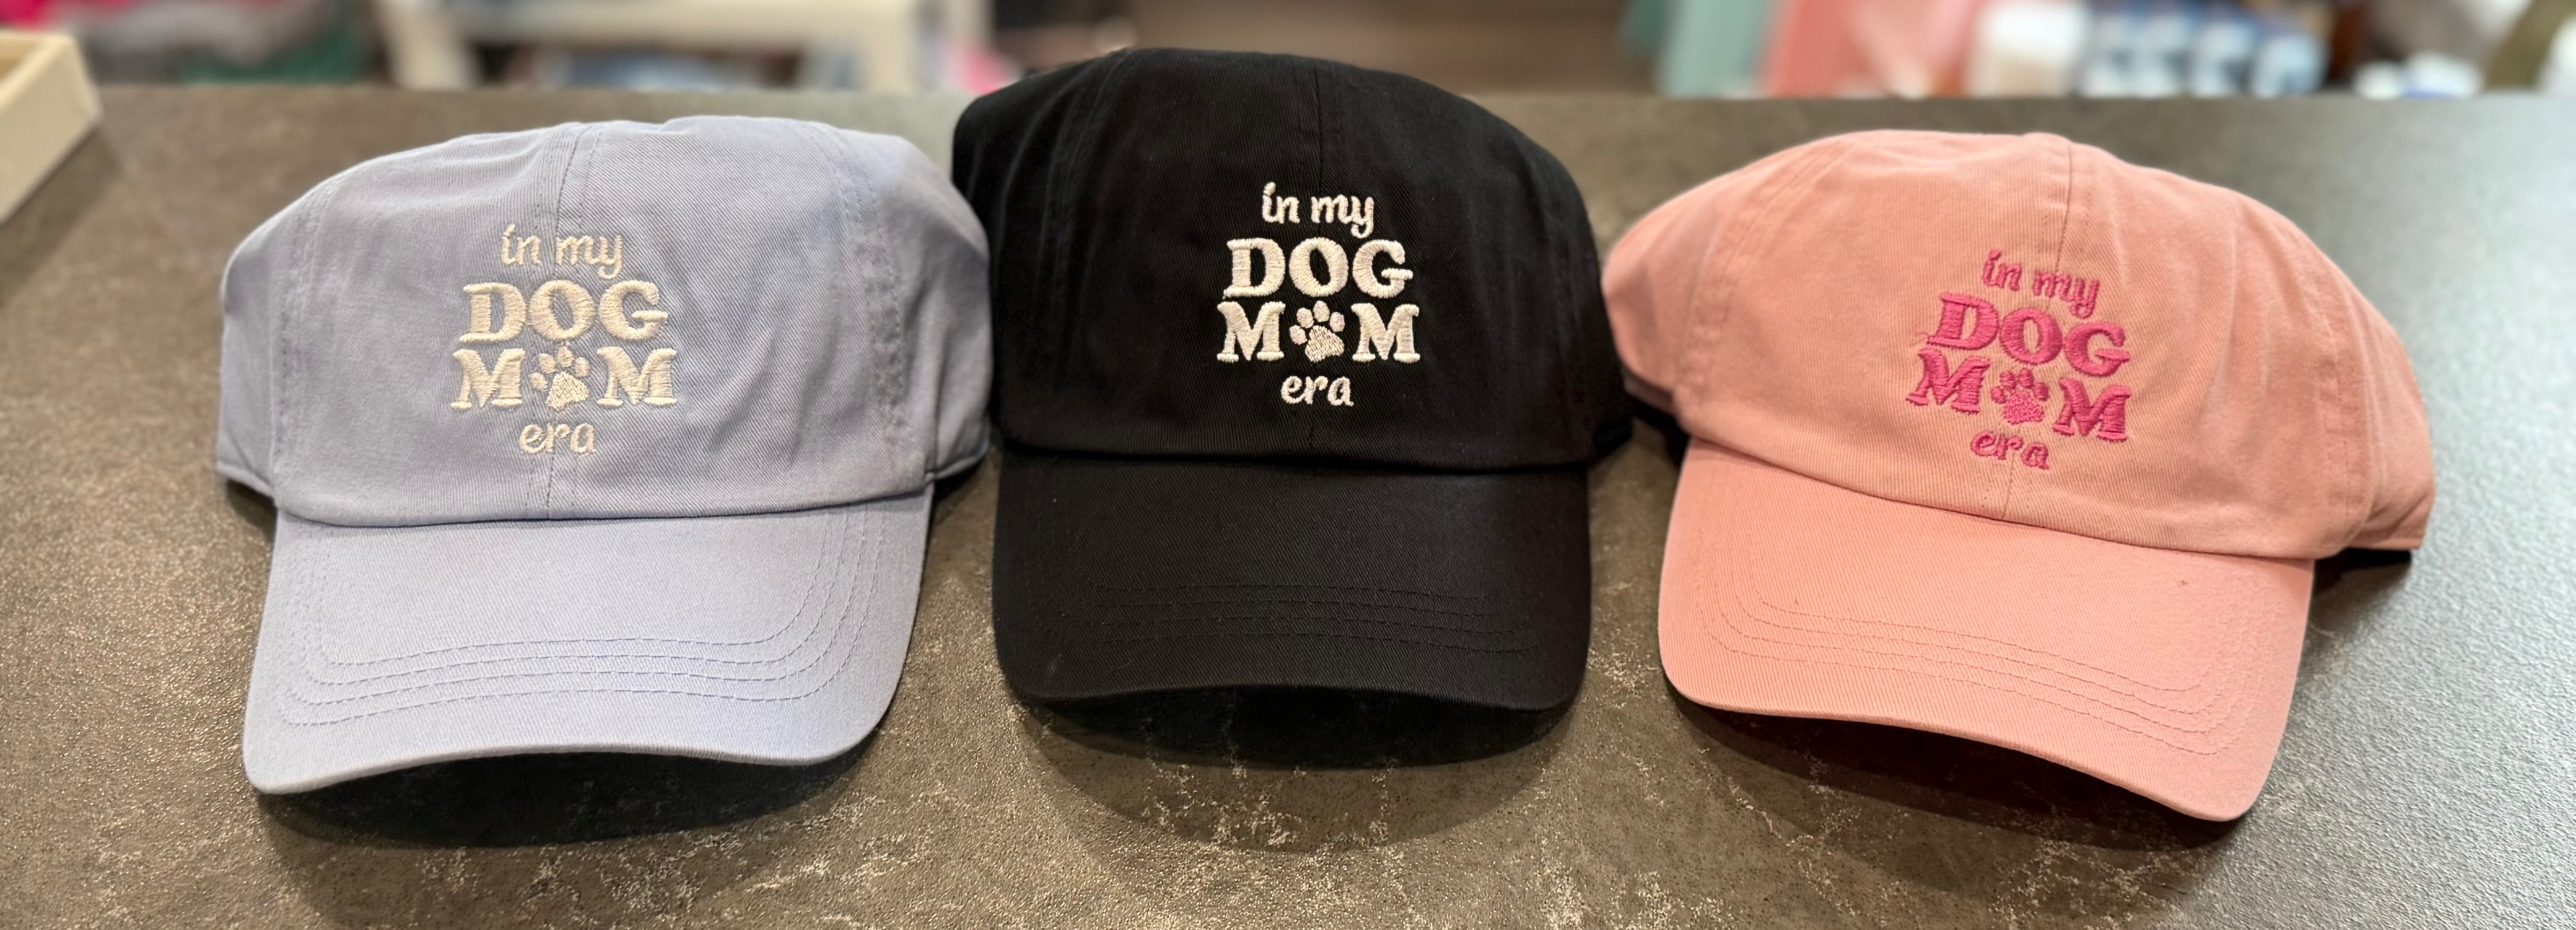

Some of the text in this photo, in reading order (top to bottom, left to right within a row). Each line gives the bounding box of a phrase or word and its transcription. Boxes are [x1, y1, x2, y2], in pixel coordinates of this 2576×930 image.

[1262, 182, 1374, 238] in my
[501, 224, 623, 279] in my
[1223, 237, 1413, 299] DOG
[460, 279, 668, 343] DOG
[1983, 249, 2100, 319] in my
[1217, 301, 1421, 362] MM
[1927, 292, 2130, 377] DOG
[451, 342, 676, 411] MM
[1281, 376, 1354, 406] era
[1905, 348, 2131, 442] MM
[520, 422, 597, 455] era
[1970, 430, 2049, 470] era
